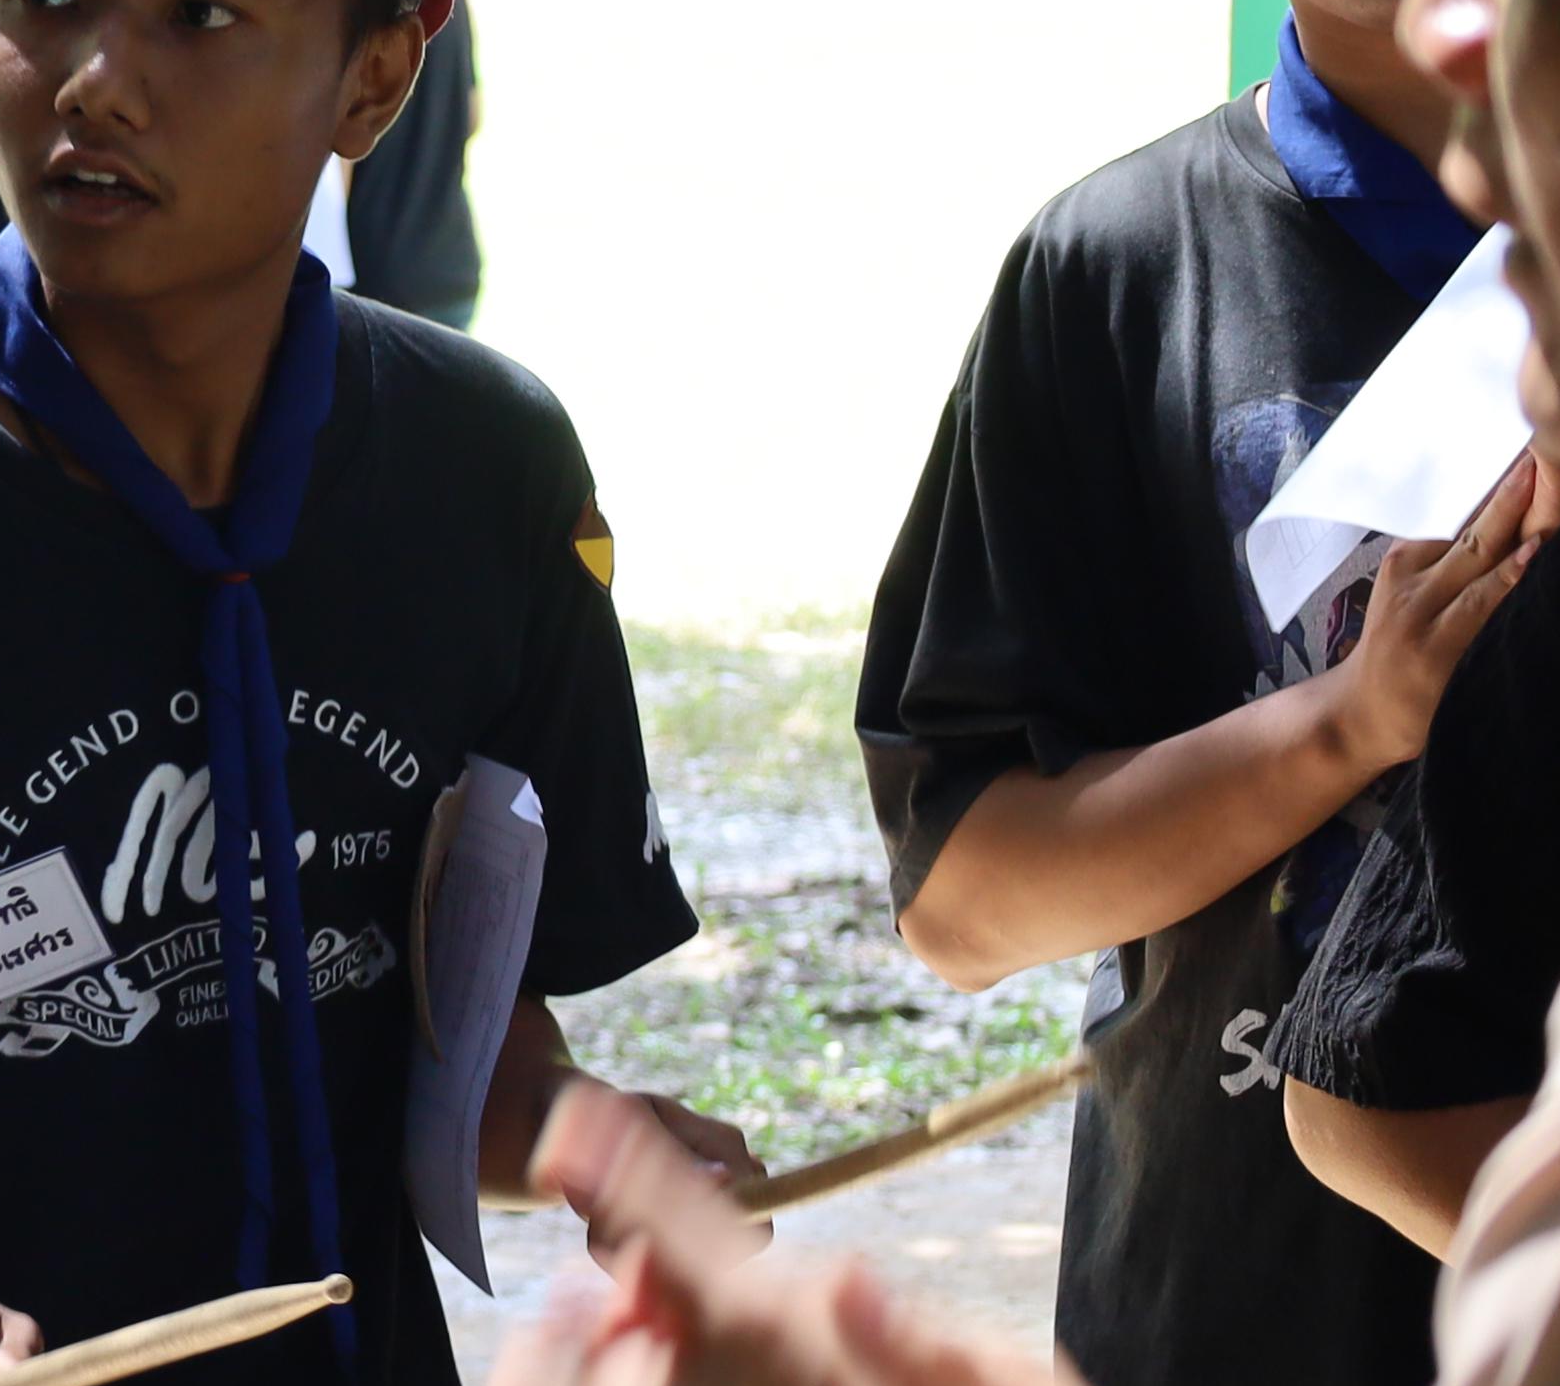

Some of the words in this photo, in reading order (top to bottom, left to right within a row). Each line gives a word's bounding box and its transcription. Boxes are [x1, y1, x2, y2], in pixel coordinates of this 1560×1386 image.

[170, 690, 200, 724] O
[288, 689, 421, 789] EGEND
[22, 1001, 123, 1039] SPECIAL
[144, 924, 268, 979] LIMITD
[179, 979, 228, 1008] FINE
[175, 1003, 230, 1028] QUALI
